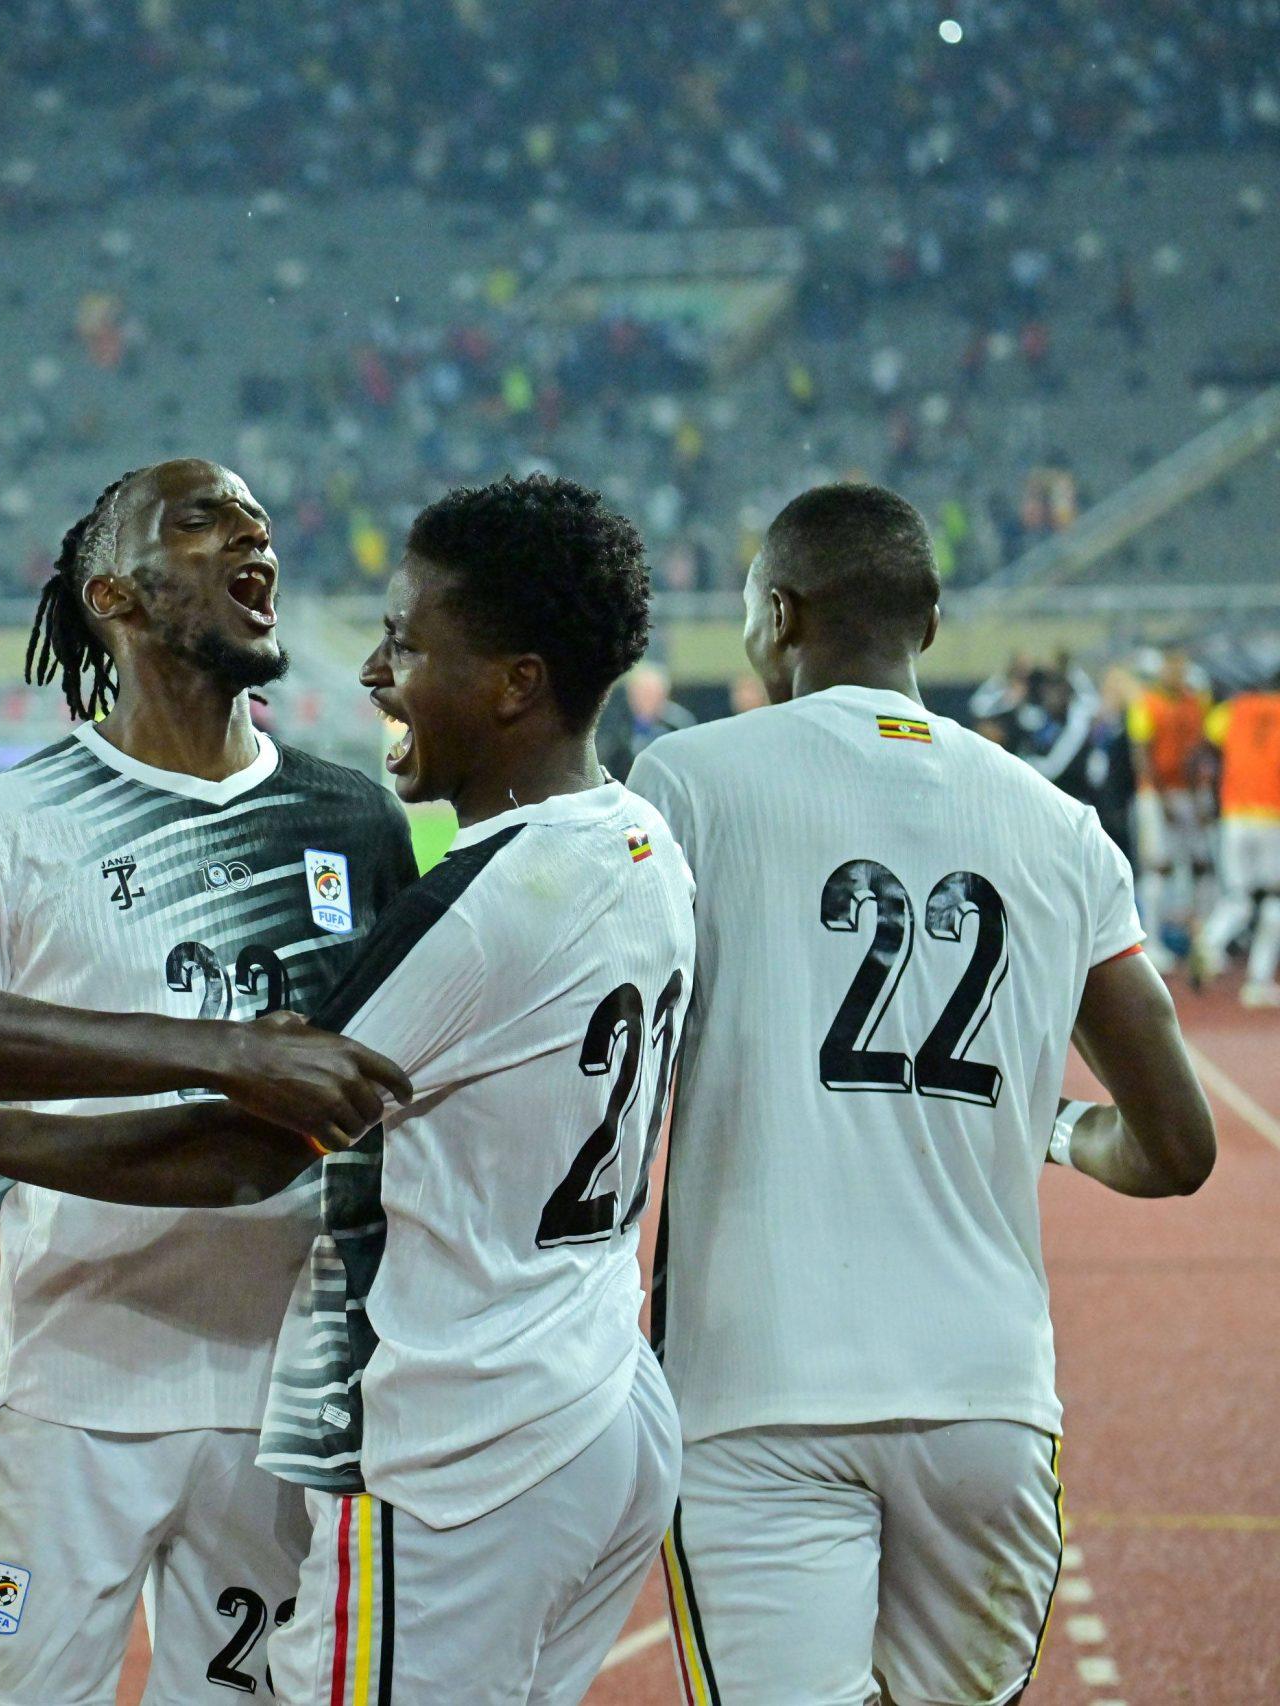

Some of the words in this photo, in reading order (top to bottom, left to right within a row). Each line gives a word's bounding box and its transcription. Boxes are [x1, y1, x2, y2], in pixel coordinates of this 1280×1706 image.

[101, 855, 134, 869] JANZI
[319, 911, 344, 925] FUFA
[820, 859, 1008, 1108] 22
